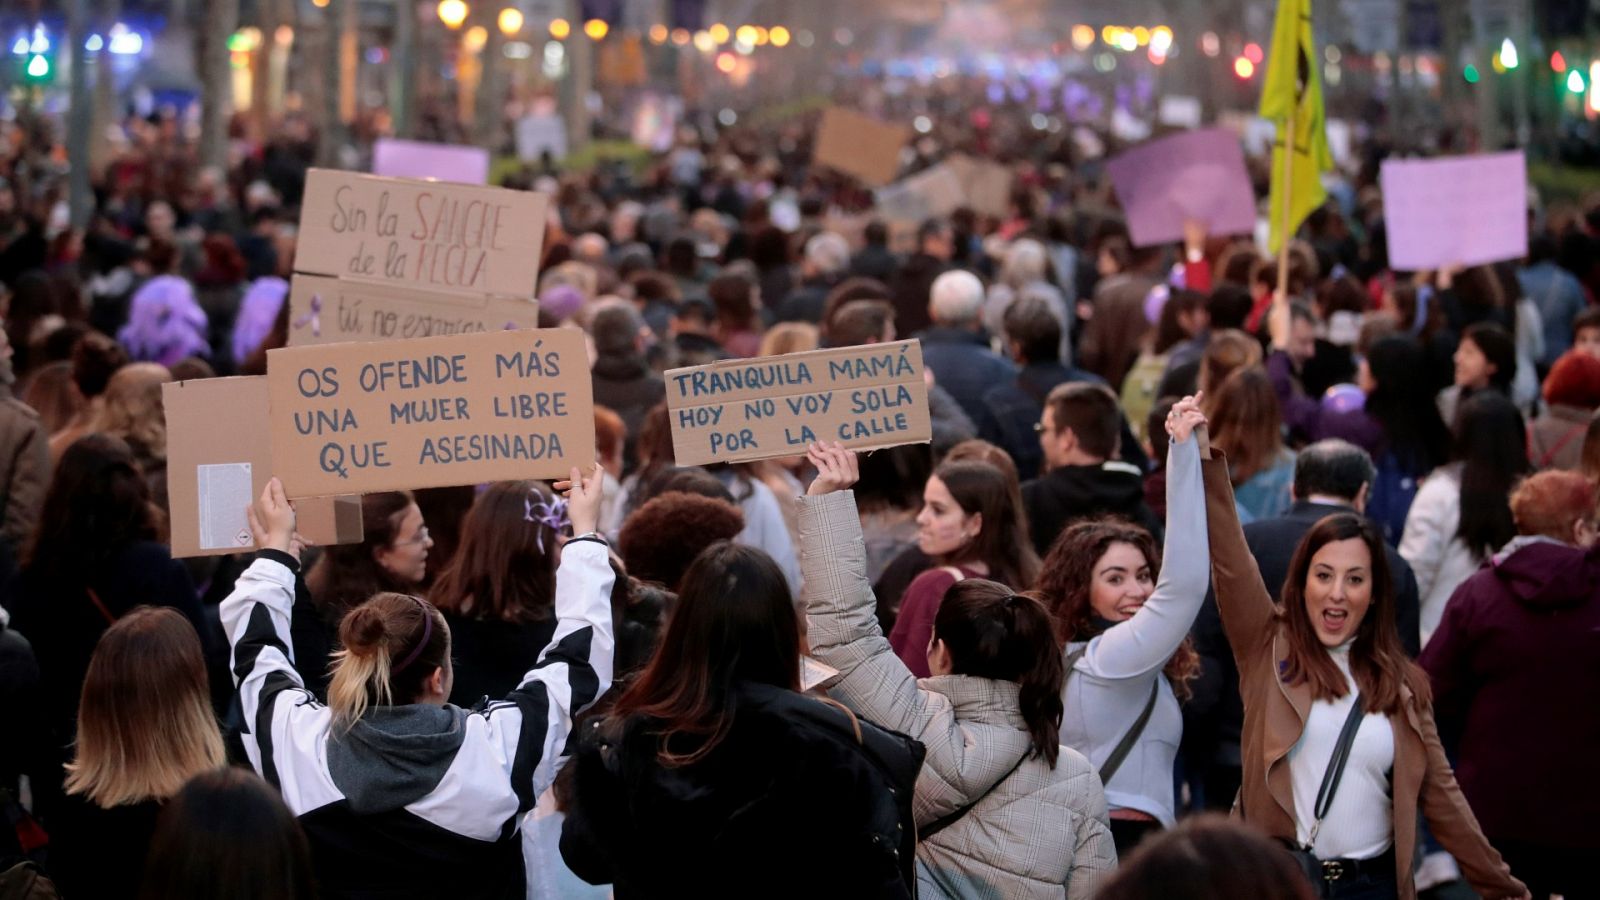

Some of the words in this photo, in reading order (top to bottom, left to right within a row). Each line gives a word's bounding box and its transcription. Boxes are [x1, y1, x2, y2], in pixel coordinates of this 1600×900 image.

[331, 185, 367, 233] Sin
[376, 191, 398, 237] la
[411, 192, 512, 251] SANGRE
[350, 242, 375, 275] de
[385, 241, 406, 279] la
[337, 295, 363, 333] tú
[372, 308, 398, 338] no
[298, 367, 339, 398] OS
[359, 354, 468, 392] OFENDE
[495, 339, 560, 379] MÁS
[673, 363, 812, 397] TRANQUILA
[828, 344, 914, 382] MAMÁ
[294, 409, 358, 435] UNA
[390, 397, 470, 425] MUJER
[493, 391, 568, 419] LIBRE
[679, 404, 724, 429] HOY
[745, 399, 775, 420] NO
[786, 391, 832, 415] VOY
[851, 384, 913, 415] SOLA
[319, 441, 391, 478] QUE
[419, 433, 563, 465] ASESINADA
[710, 428, 758, 455] POR
[785, 424, 816, 446] LA
[838, 413, 908, 440] CALLE
